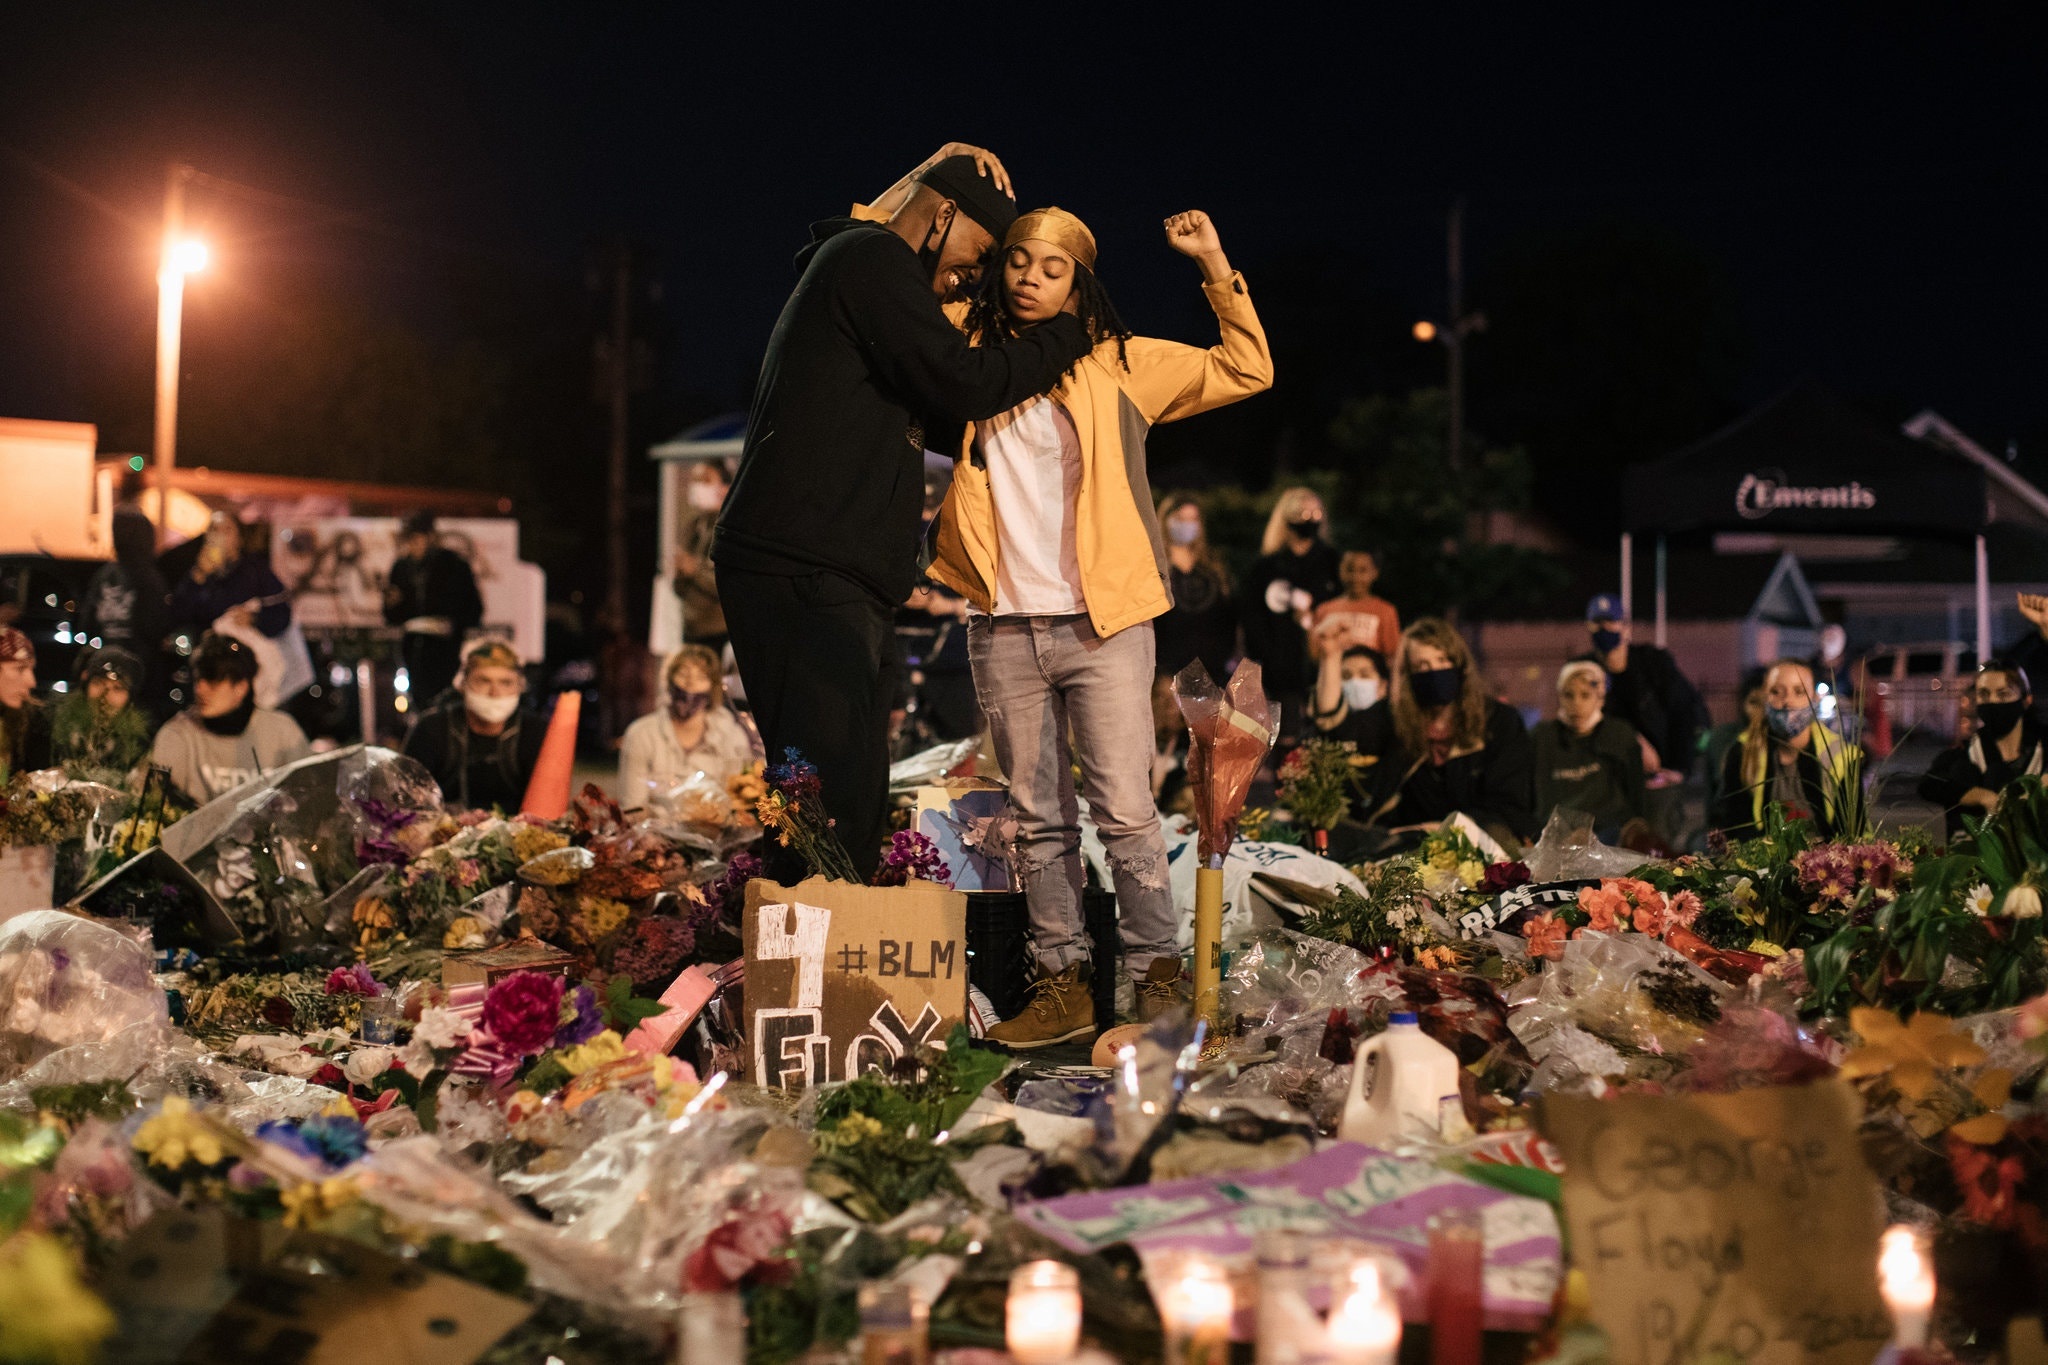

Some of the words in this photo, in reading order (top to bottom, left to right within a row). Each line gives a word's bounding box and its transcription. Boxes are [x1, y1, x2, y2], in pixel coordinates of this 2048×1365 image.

[1752, 478, 1876, 509] Enventis
[837, 940, 956, 979] #BLM
[1584, 1111, 1840, 1202] George
